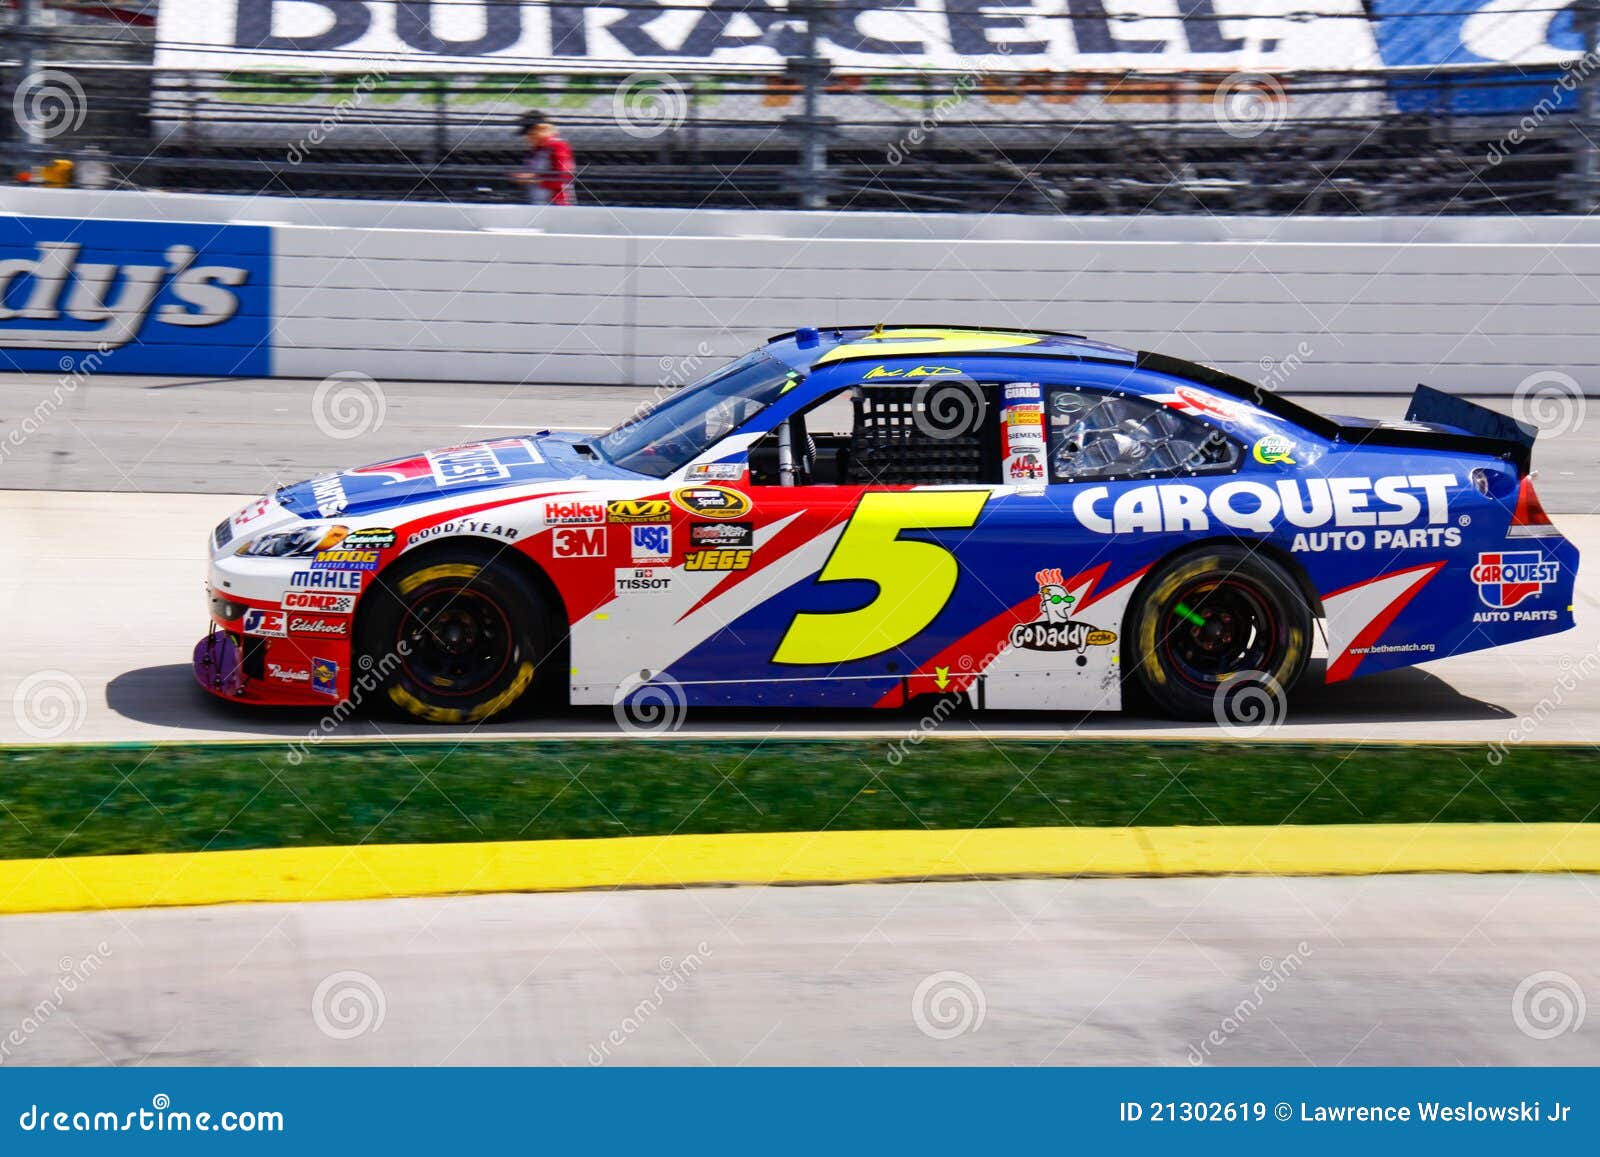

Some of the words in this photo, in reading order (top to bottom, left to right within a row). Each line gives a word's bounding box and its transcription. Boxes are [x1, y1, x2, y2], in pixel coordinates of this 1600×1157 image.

[1008, 432, 1042, 440] SIEMENS
[698, 498, 725, 507] Sprint
[1073, 473, 1458, 534] CARQUEST
[545, 503, 603, 521] Holley
[408, 521, 519, 544] GOODYEAR
[634, 526, 669, 554] USG
[1291, 531, 1366, 552] AUTO
[1374, 527, 1462, 549] PARTS
[556, 528, 604, 557] 3M
[315, 551, 378, 562] MOOG
[685, 550, 752, 570] JEGS
[290, 571, 360, 588] MAHLE
[770, 490, 993, 664] 5
[1471, 562, 1559, 584] CARQUEST
[617, 578, 672, 589] TISSOT
[286, 594, 337, 608] COMP
[1472, 612, 1510, 622] AUTO
[1513, 610, 1558, 621] PARTS
[290, 618, 347, 634] Edelbrock
[1350, 643, 1436, 655] www.bethematch.org
